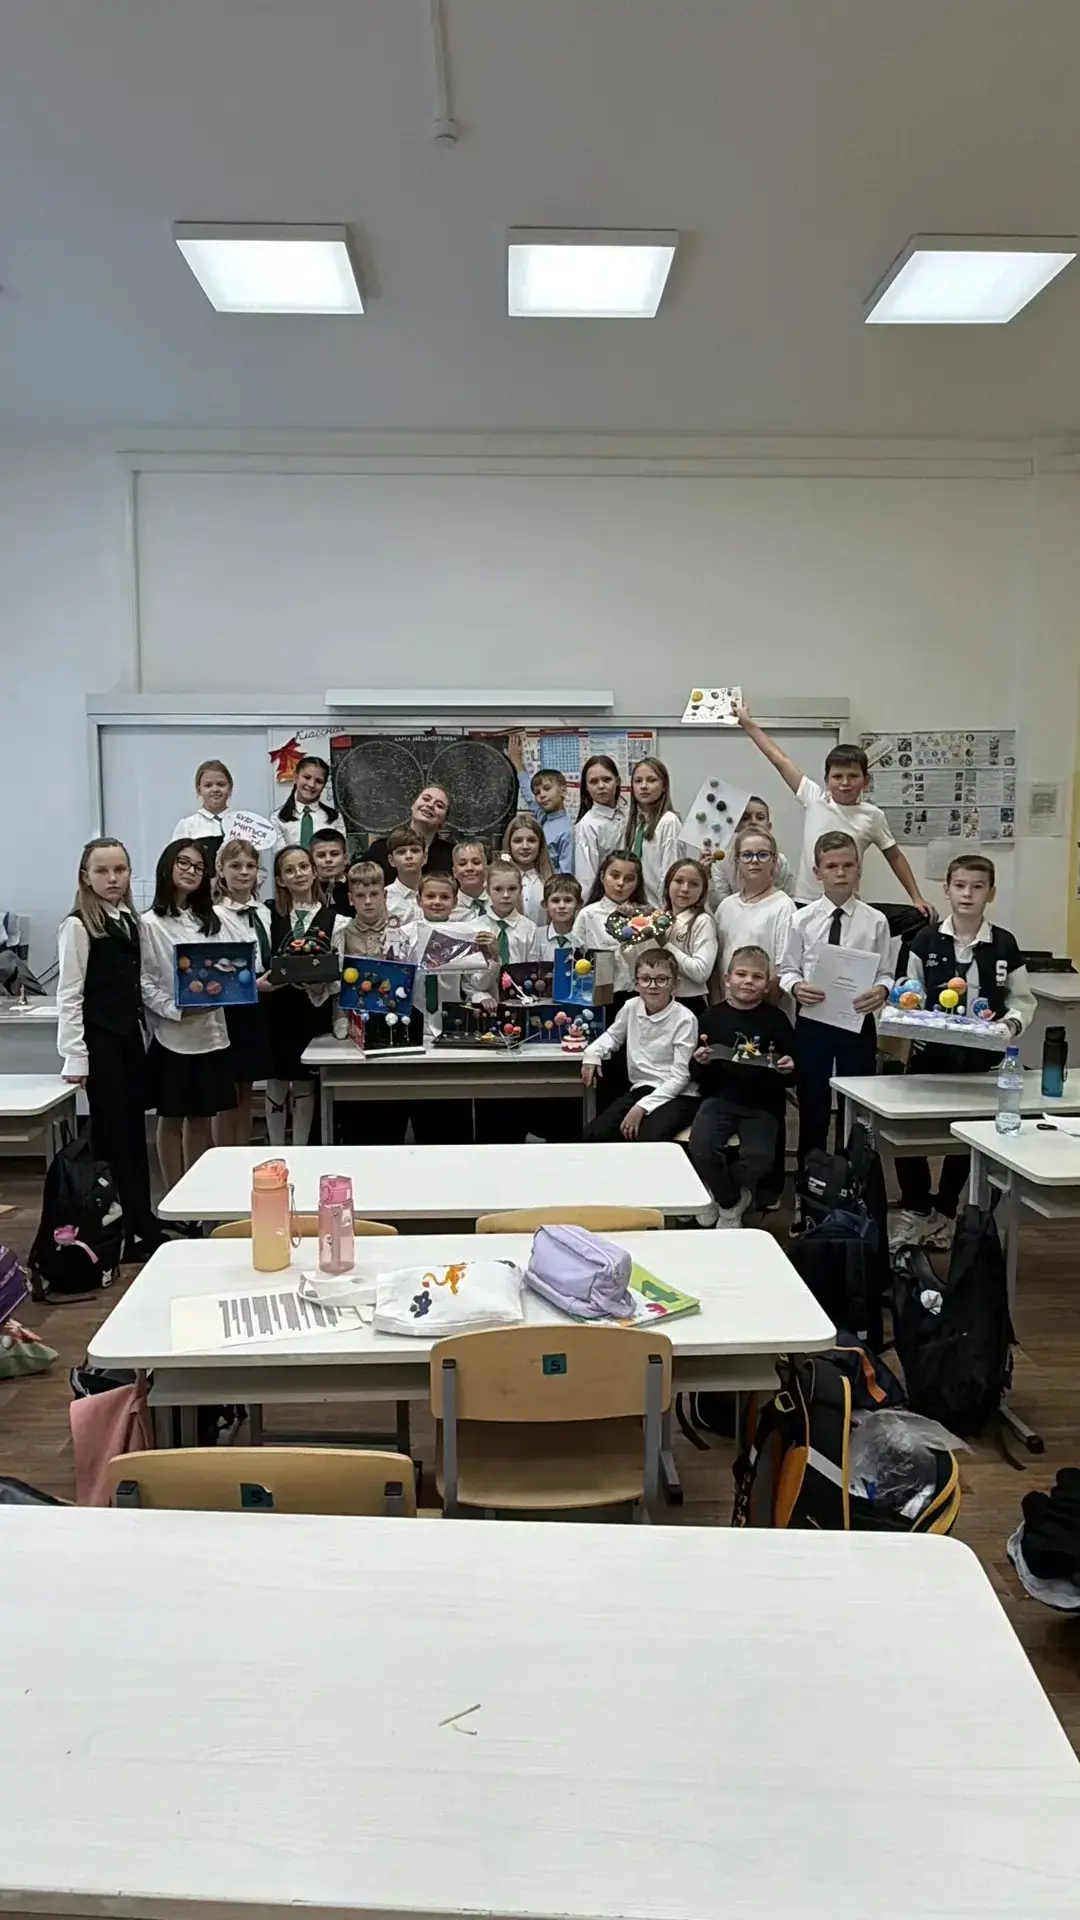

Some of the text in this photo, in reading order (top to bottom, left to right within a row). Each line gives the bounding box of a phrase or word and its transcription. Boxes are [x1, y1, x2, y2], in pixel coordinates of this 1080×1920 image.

[295, 726, 345, 740] Классная
[236, 813, 255, 824] БУДУ
[233, 820, 267, 838] УЧИТЬСЯ
[996, 960, 1008, 982] S
[549, 1360, 562, 1372] 5
